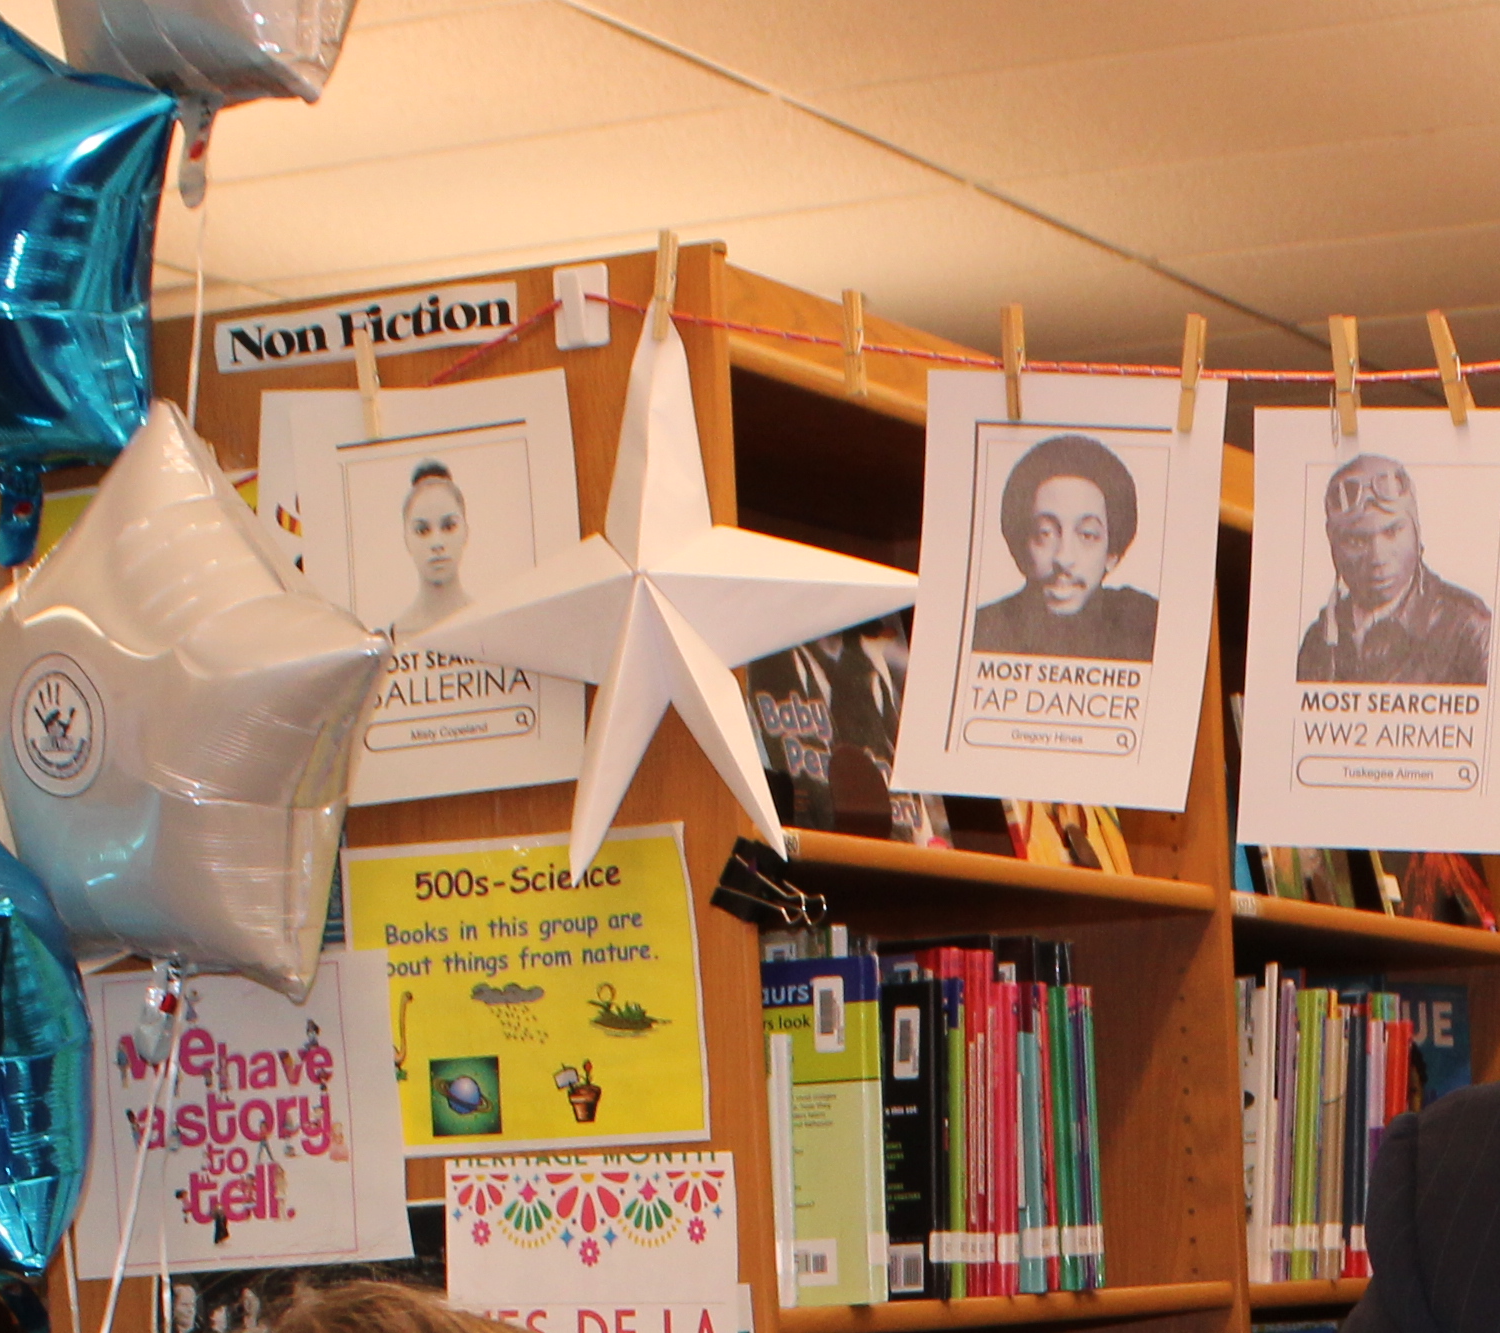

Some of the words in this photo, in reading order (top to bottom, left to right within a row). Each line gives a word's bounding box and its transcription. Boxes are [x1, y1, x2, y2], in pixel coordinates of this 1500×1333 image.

[230, 323, 329, 363] Non
[339, 294, 513, 347] Fiction
[374, 666, 532, 709] ALLERINA
[978, 660, 1033, 682] MOST
[1038, 663, 1141, 688] SEARCHED
[757, 692, 832, 740] Baby
[972, 685, 1018, 711] TAP
[1026, 688, 1140, 721] DANCER
[1301, 691, 1361, 712] MOST
[1368, 692, 1481, 714] SEARCHED
[1304, 721, 1368, 746] WW2
[1376, 724, 1474, 749] AIRMEN
[1343, 766, 1394, 780] Tuskegee
[1397, 767, 1434, 780] Airmen
[385, 922, 449, 946] Books
[459, 921, 478, 940] in
[487, 916, 529, 938] this
[539, 917, 599, 941] group
[608, 912, 644, 930] are
[443, 953, 509, 978] things
[519, 947, 573, 971] from
[582, 943, 659, 966] nature.
[216, 1042, 334, 1091] have
[175, 1092, 331, 1156] story
[206, 1143, 249, 1175] to
[188, 1162, 297, 1224] tell.
